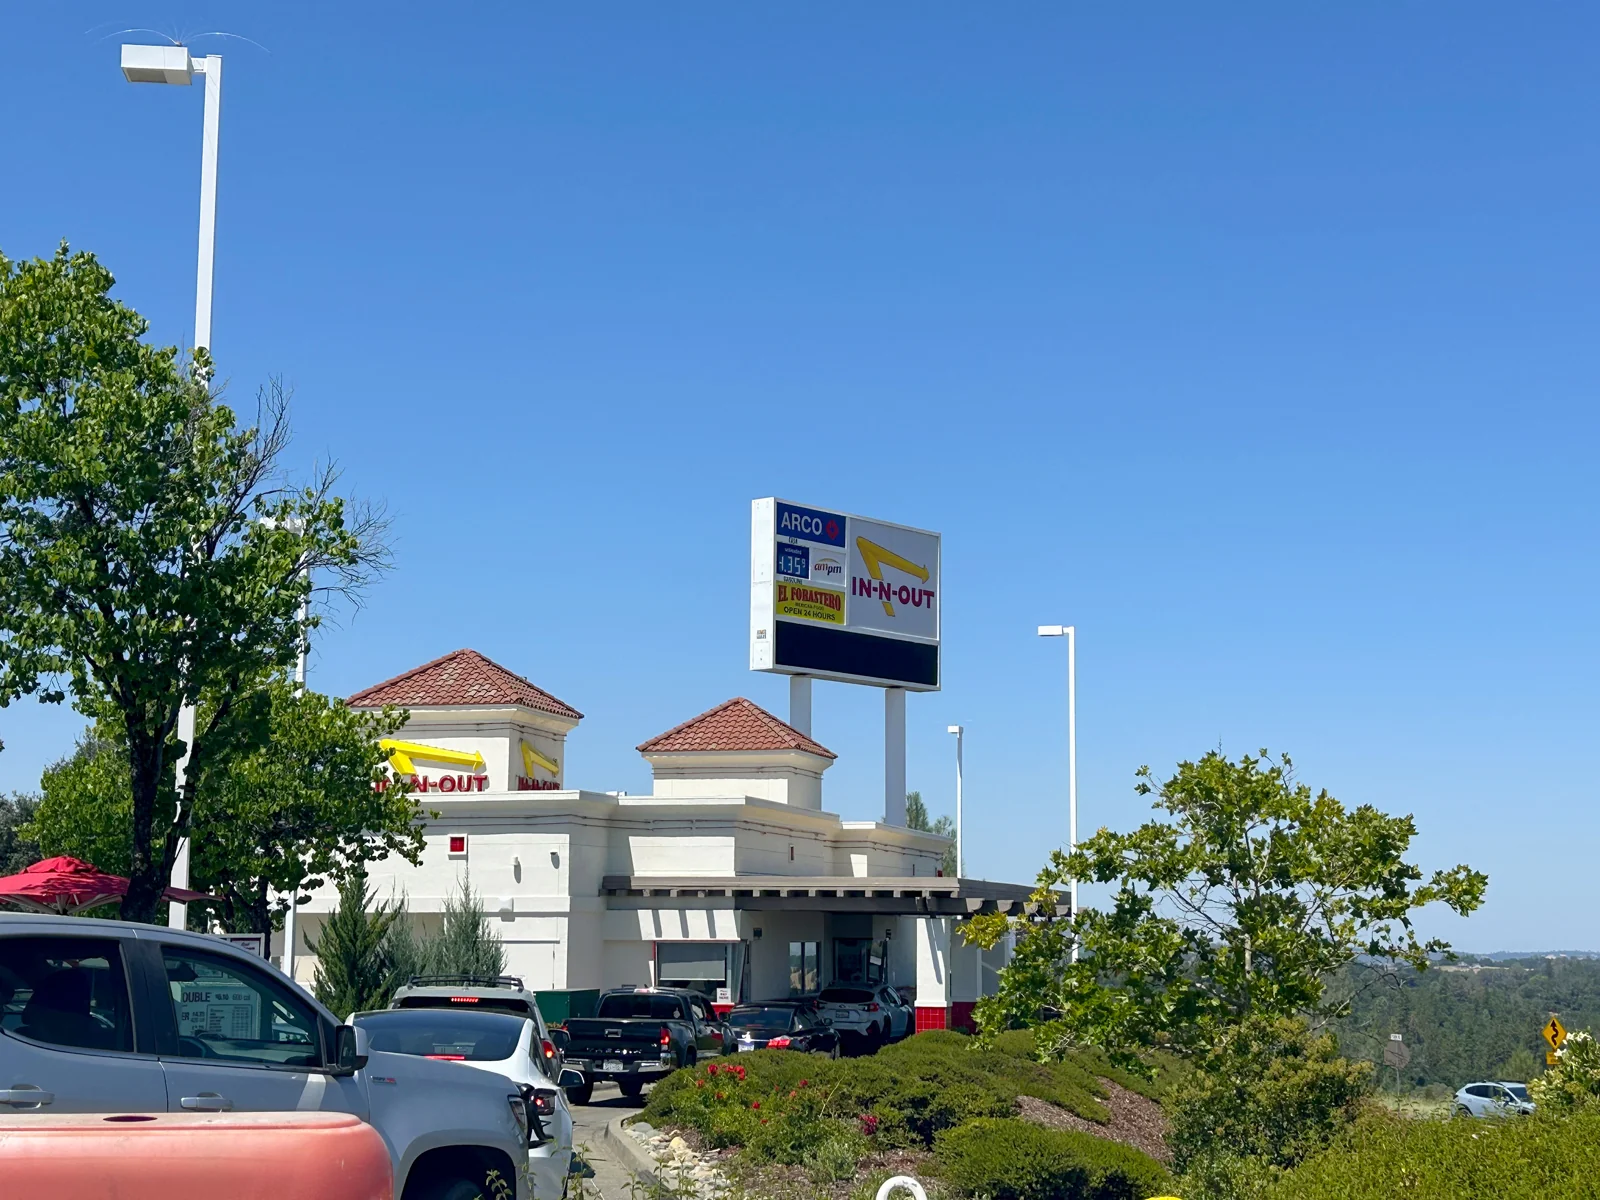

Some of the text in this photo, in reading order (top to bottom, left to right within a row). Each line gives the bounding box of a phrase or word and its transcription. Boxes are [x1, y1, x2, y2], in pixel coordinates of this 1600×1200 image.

[781, 511, 823, 536] ARCO
[814, 563, 842, 576] ampm
[777, 585, 842, 612] EL FORASTERO
[852, 576, 935, 609] IN-N-OUT
[783, 606, 802, 615] OPEN
[812, 611, 836, 621] HOURS
[182, 992, 212, 1003] OUBLE
